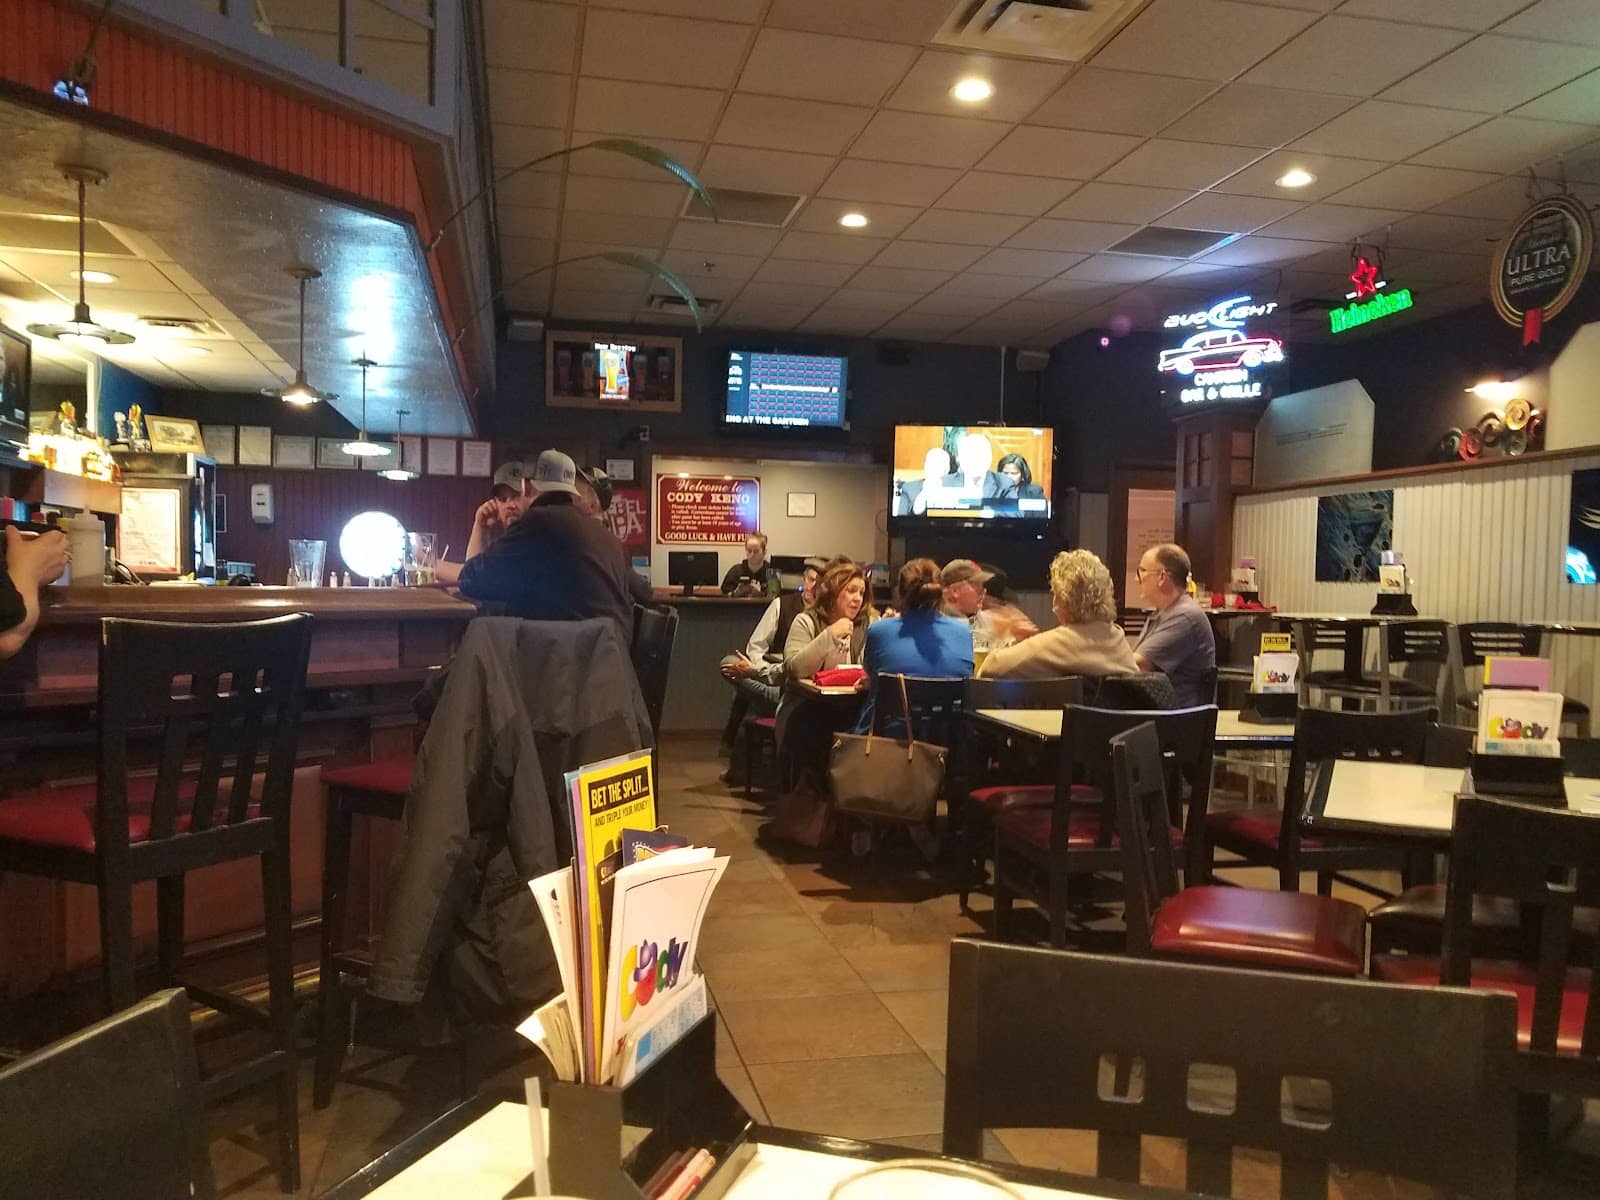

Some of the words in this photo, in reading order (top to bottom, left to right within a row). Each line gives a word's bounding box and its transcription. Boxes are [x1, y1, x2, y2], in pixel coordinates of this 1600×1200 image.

[1506, 243, 1571, 275] ULTRA
[1511, 273, 1536, 287] PURE
[1538, 265, 1566, 279] GOLD
[1329, 288, 1414, 334] Heineken
[675, 479, 729, 492] Welcome
[731, 481, 743, 493] to
[667, 491, 704, 503] CODY
[710, 493, 750, 504] KENO
[664, 531, 687, 540] GOOD
[688, 532, 708, 541] LUCK
[709, 532, 716, 541] &
[716, 532, 736, 542] HAVE
[590, 786, 607, 809] BET
[607, 781, 622, 804] THE
[594, 815, 606, 827] AND
[606, 812, 621, 824] TRIPLE
[622, 806, 632, 818] YOUR
